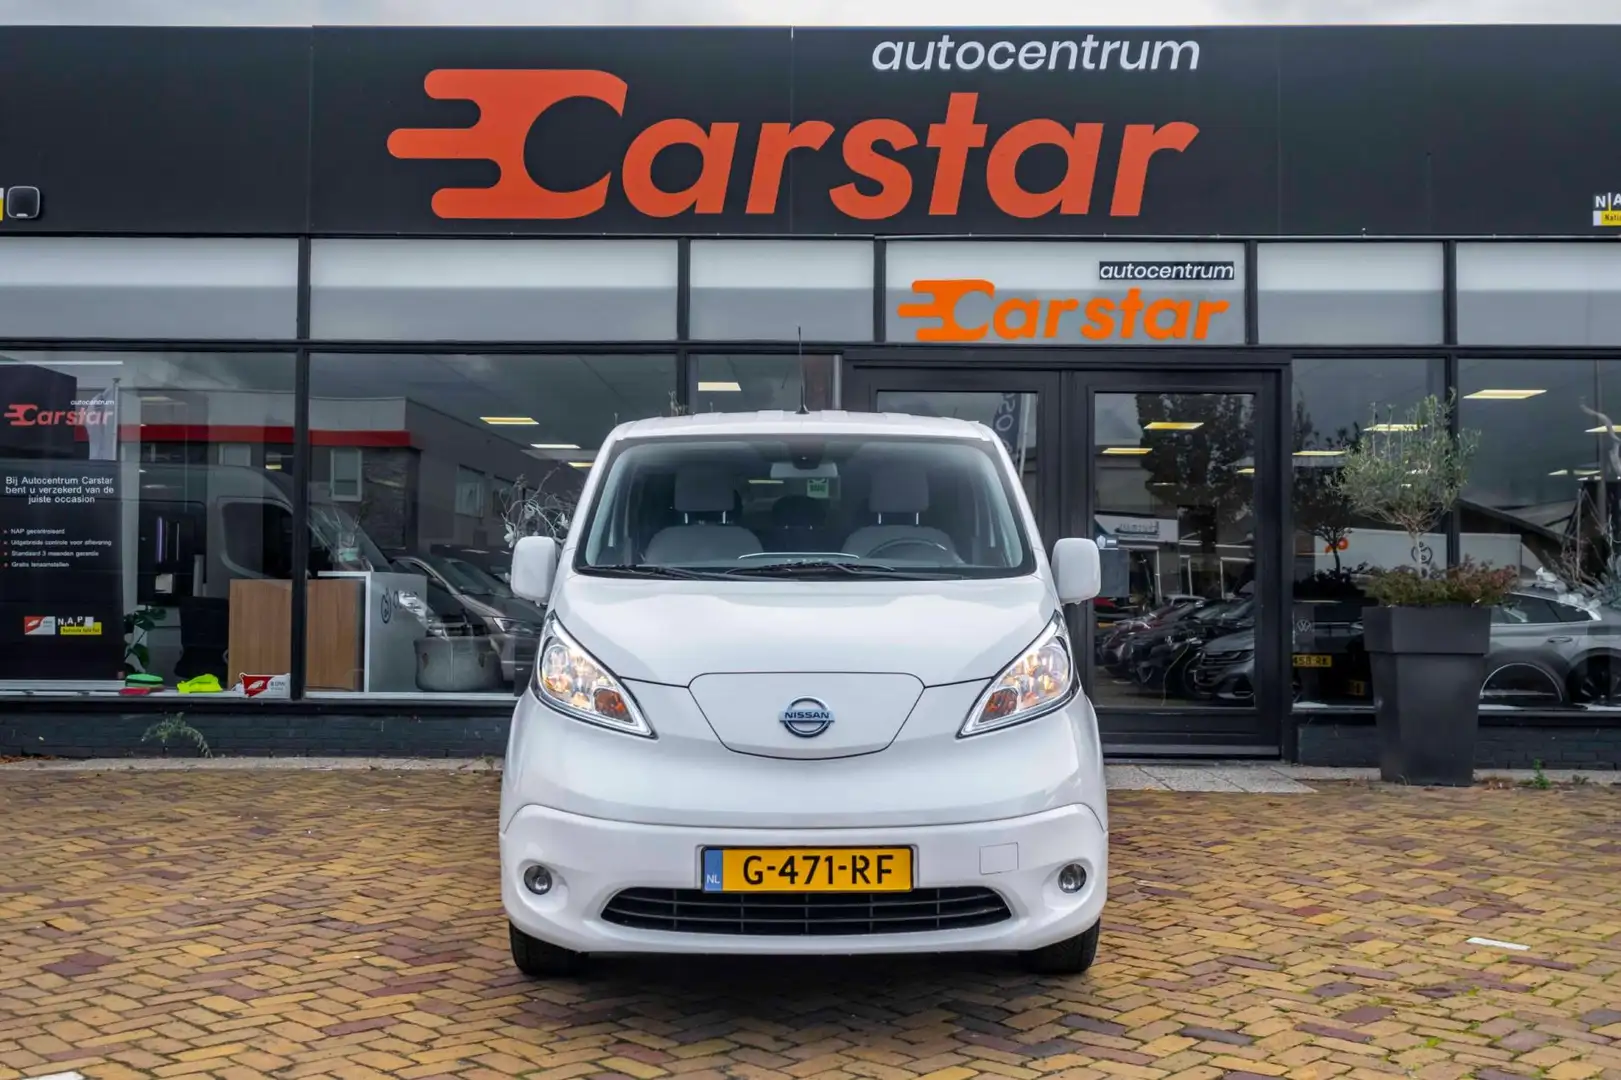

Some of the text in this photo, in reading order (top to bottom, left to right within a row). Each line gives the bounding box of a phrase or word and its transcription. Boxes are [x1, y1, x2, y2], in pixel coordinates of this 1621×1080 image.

[872, 33, 1200, 72] autocentrum
[387, 69, 1199, 219] Carstar
[1099, 263, 1234, 280] autocentrum
[897, 279, 1230, 342] Carstar
[3, 404, 114, 426] Carstar
[5, 476, 114, 487] Bij Autocentrum Carstar
[5, 486, 26, 494] bent
[38, 486, 82, 494] verzekerd
[103, 486, 114, 494] de
[28, 495, 96, 505] juiste occasion
[784, 711, 830, 719] NISSAN
[706, 854, 894, 886] NL G-471-RF
